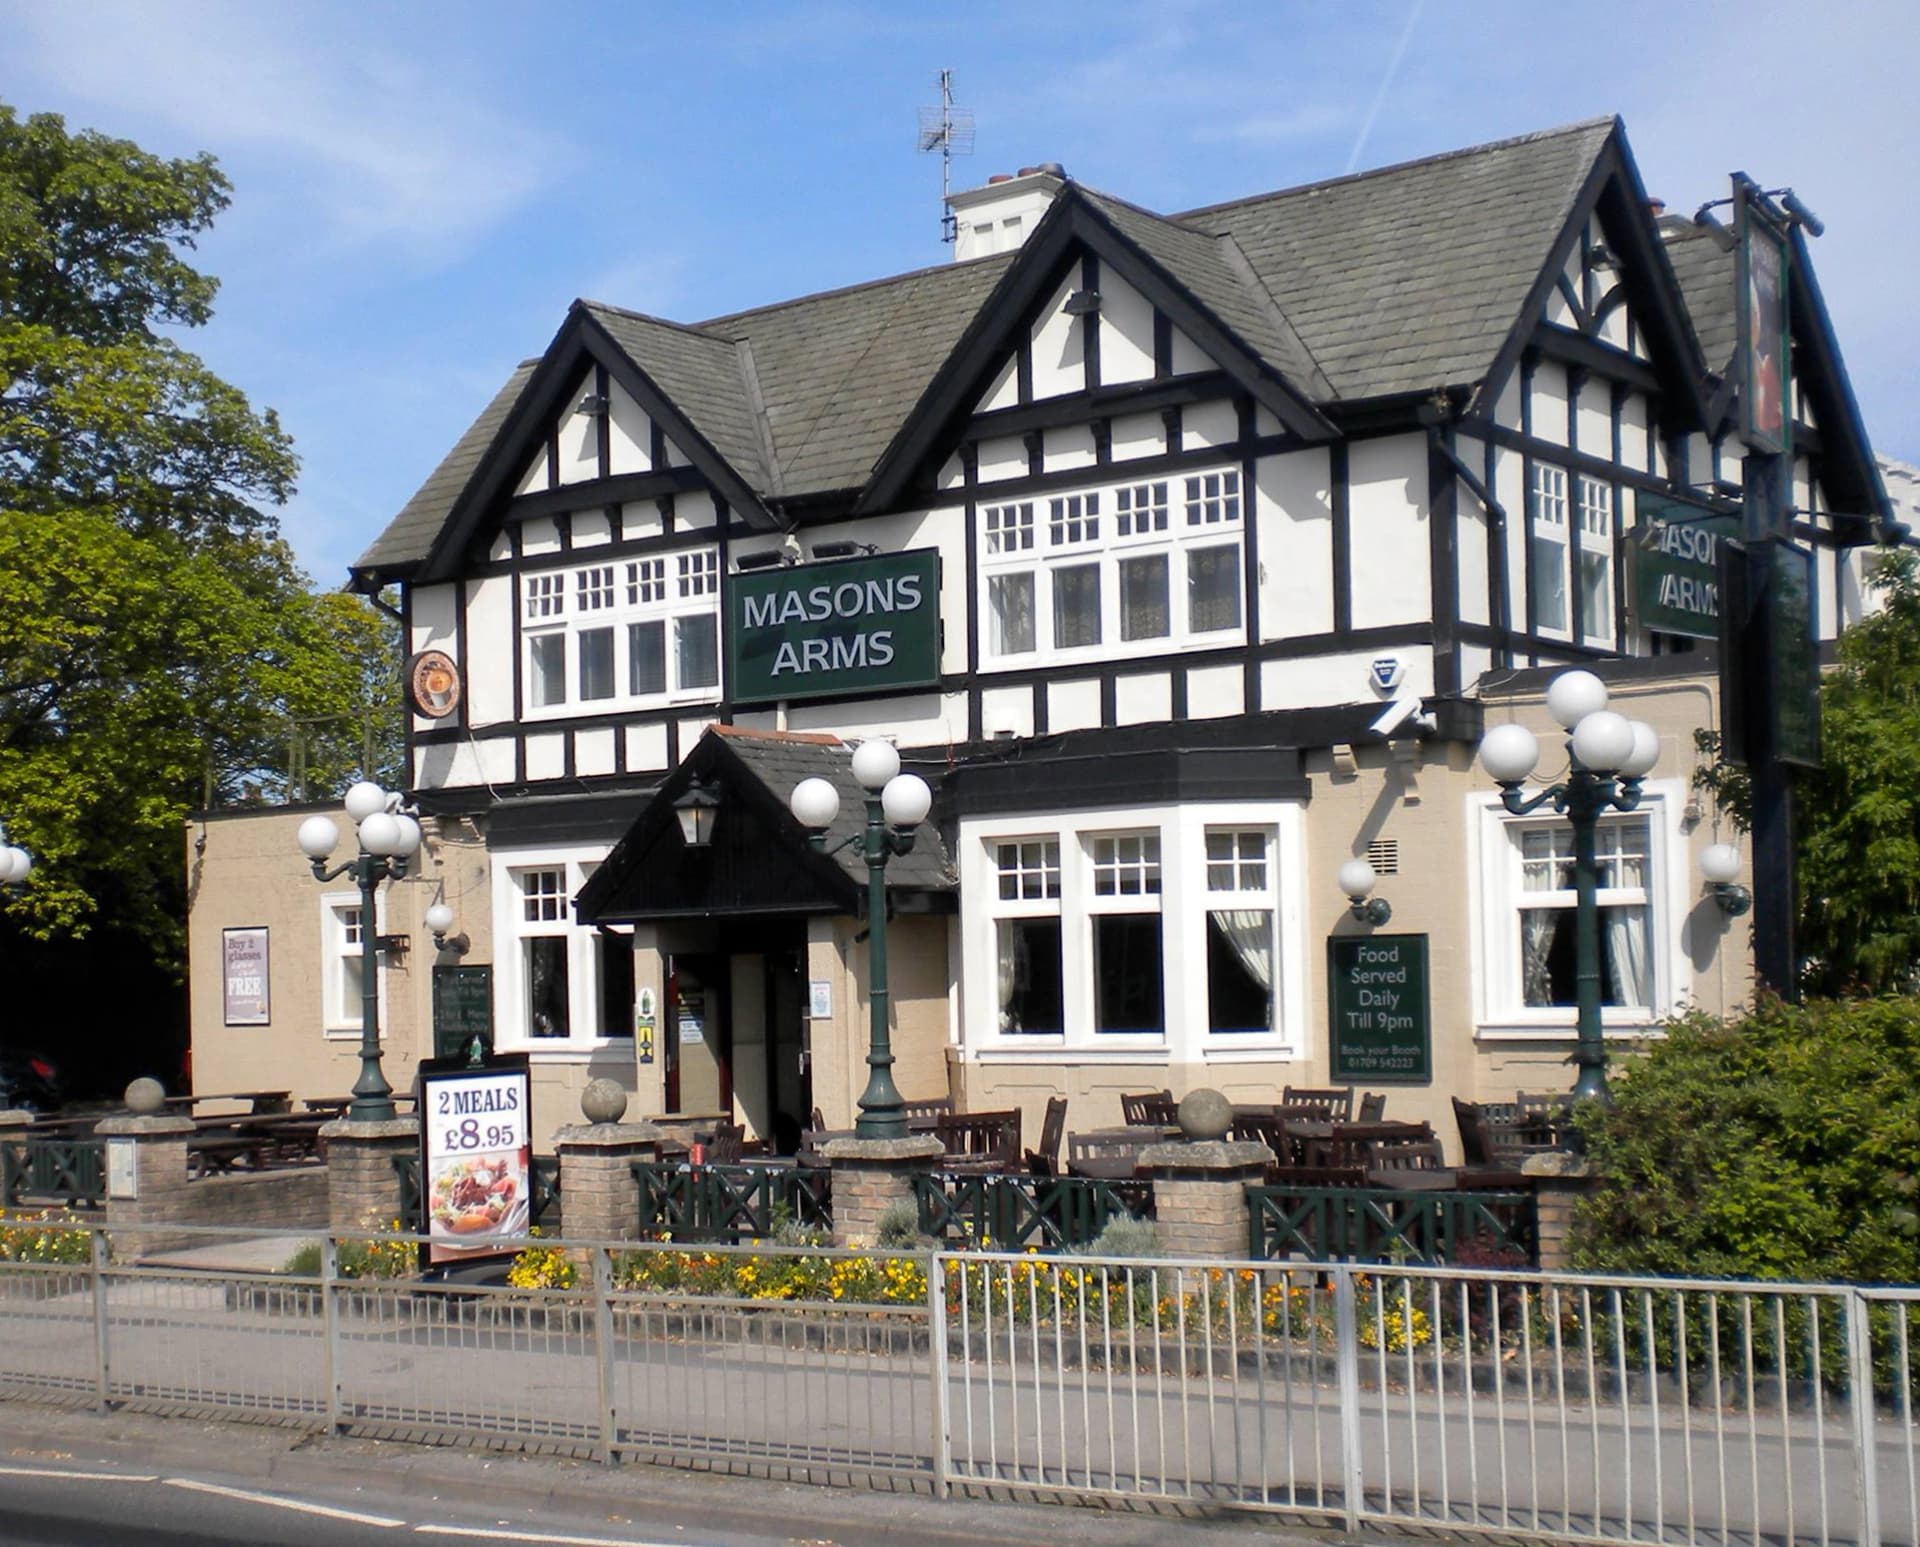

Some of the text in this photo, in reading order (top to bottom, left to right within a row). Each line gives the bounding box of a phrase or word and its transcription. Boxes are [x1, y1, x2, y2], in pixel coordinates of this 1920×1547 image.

[743, 575, 922, 629] MASONS
[770, 630, 895, 676] ARMS
[1358, 945, 1399, 963] Food
[228, 976, 261, 996] FREE
[1351, 966, 1407, 984] Served
[1359, 989, 1400, 1010] Daily
[1346, 1011, 1414, 1033] Till 9pm
[439, 1087, 518, 1115] 2 MEALS
[445, 1118, 515, 1151] £8.95
